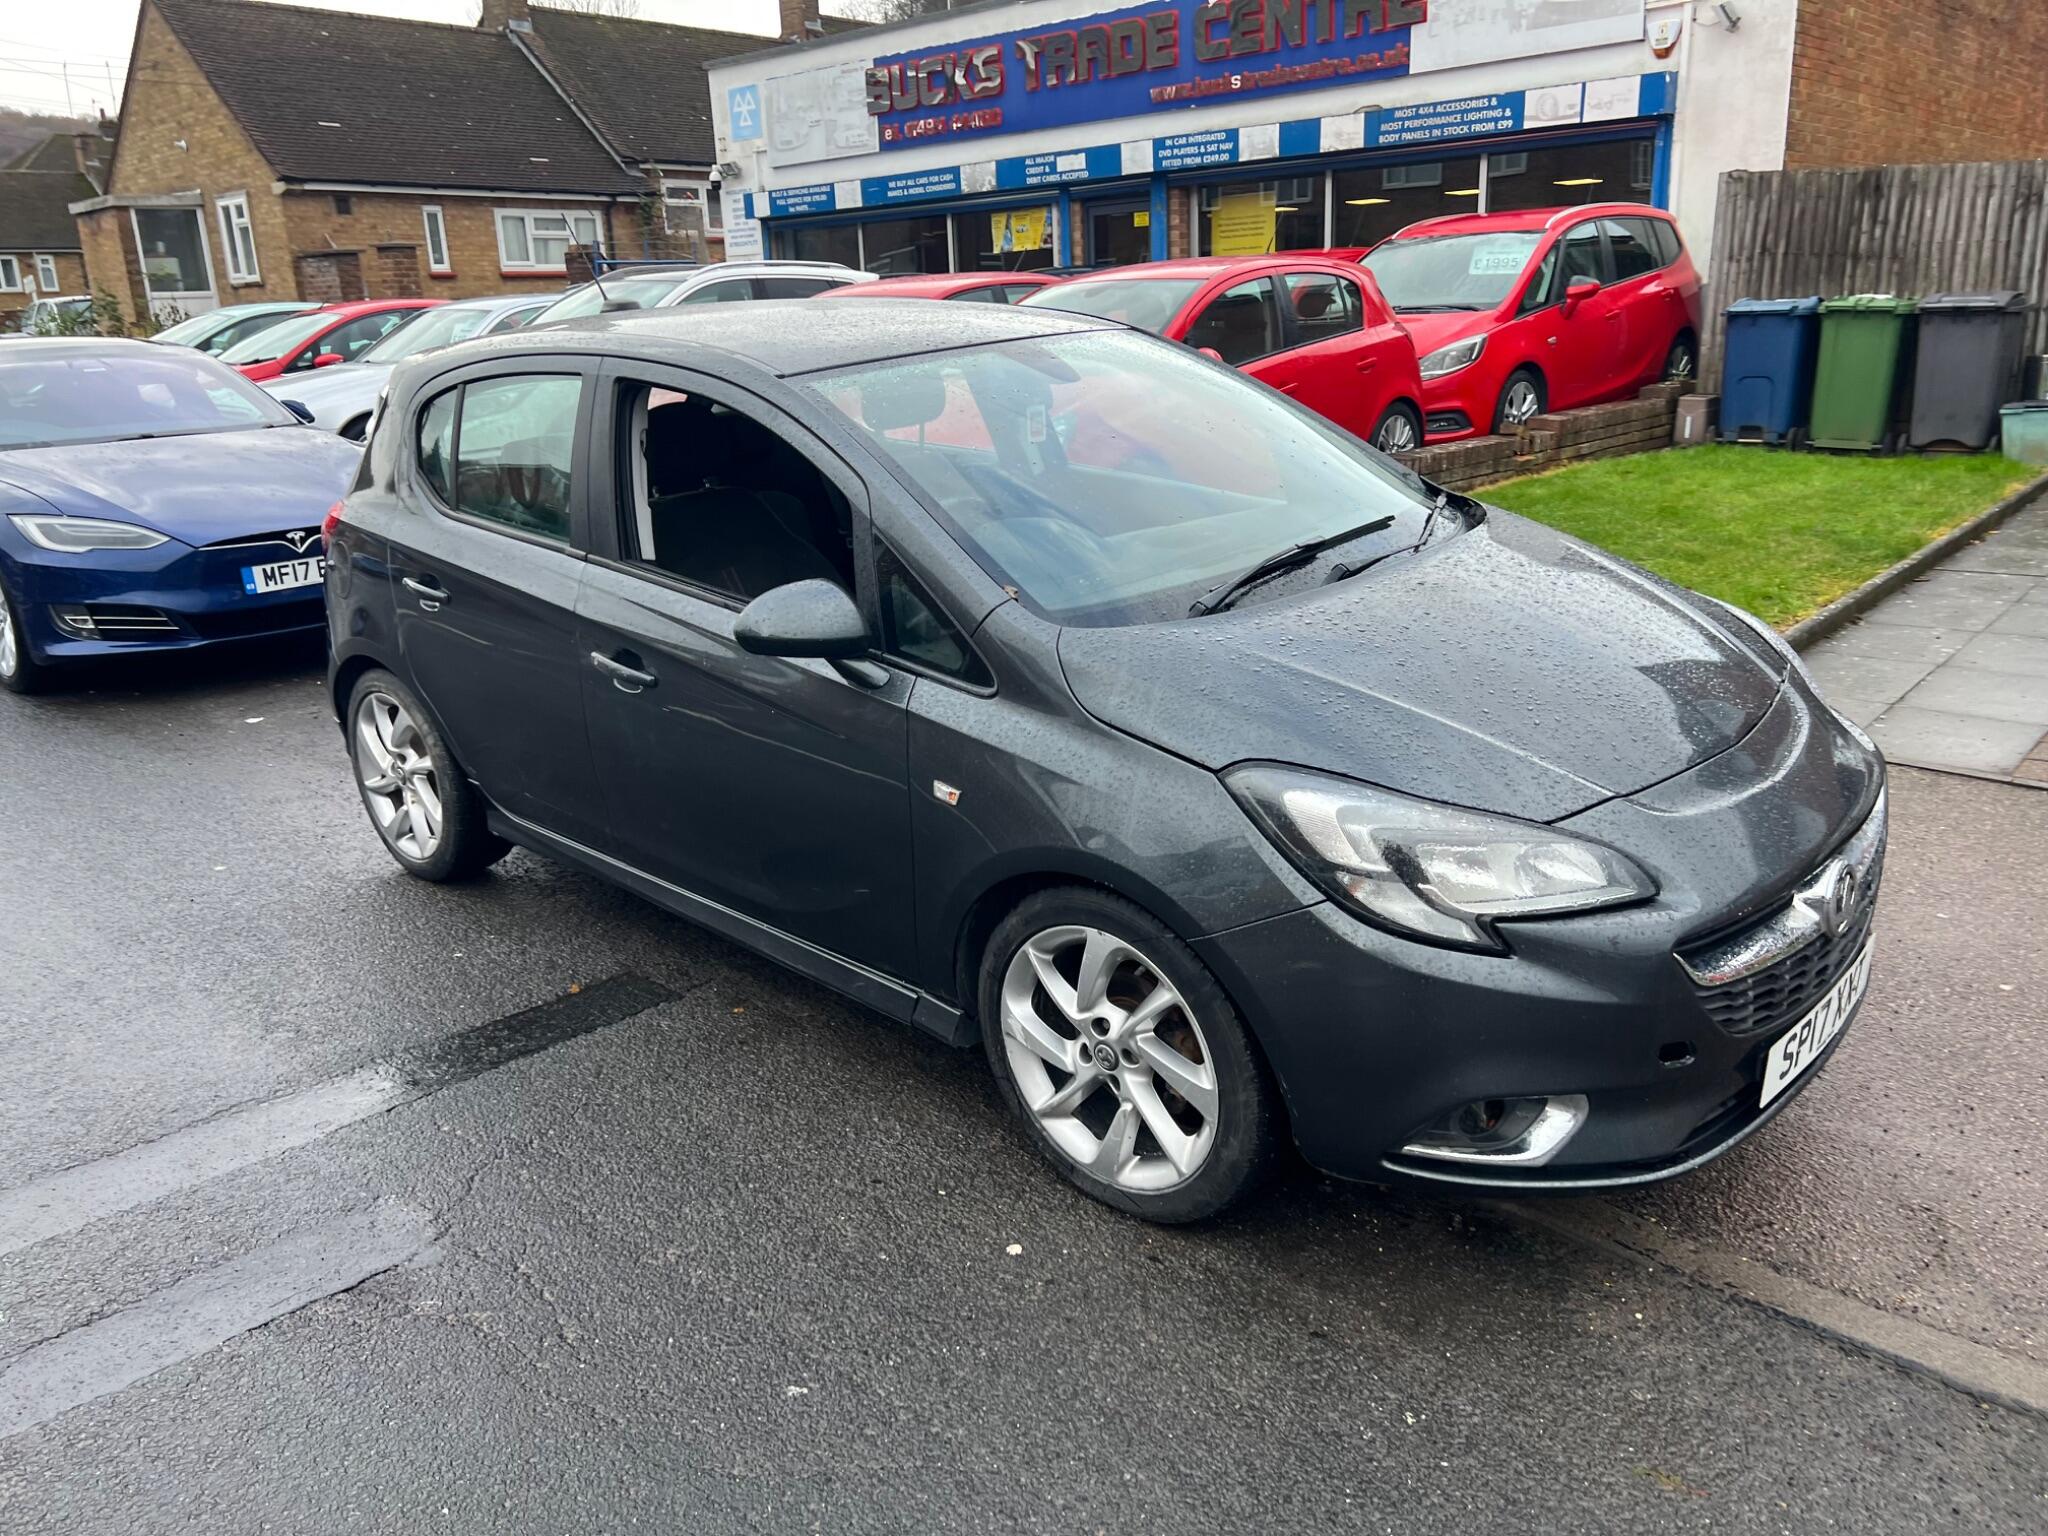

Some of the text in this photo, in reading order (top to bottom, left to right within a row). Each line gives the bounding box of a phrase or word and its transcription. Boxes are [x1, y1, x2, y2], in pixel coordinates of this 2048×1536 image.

[865, 44, 1005, 116] BUCKS
[1015, 10, 1180, 92] TRADE
[1394, 97, 1497, 118] MOST 4X4 ACCESSORIES &
[1380, 108, 1512, 131] MOST PERFORMANCE LIGHTING &
[1174, 137, 1187, 145] CAR
[1188, 132, 1226, 144] INTEGRATED
[1379, 134, 1400, 143] BODY
[1401, 130, 1430, 140] PANELS
[1443, 124, 1470, 135] STOCK
[1471, 122, 1495, 132] FROM
[1497, 120, 1513, 129] £99
[1158, 149, 1171, 157] DVD
[1173, 146, 1199, 156] PLAYERS
[1206, 144, 1218, 152] SAT
[1220, 142, 1234, 150] NAV
[1162, 159, 1182, 168] FITTED
[1183, 156, 1201, 164] FROM
[1026, 170, 1089, 184] DEBIT CARDS ACCEPTED
[262, 561, 309, 587] MF17
[1779, 997, 1832, 1080] SP17
